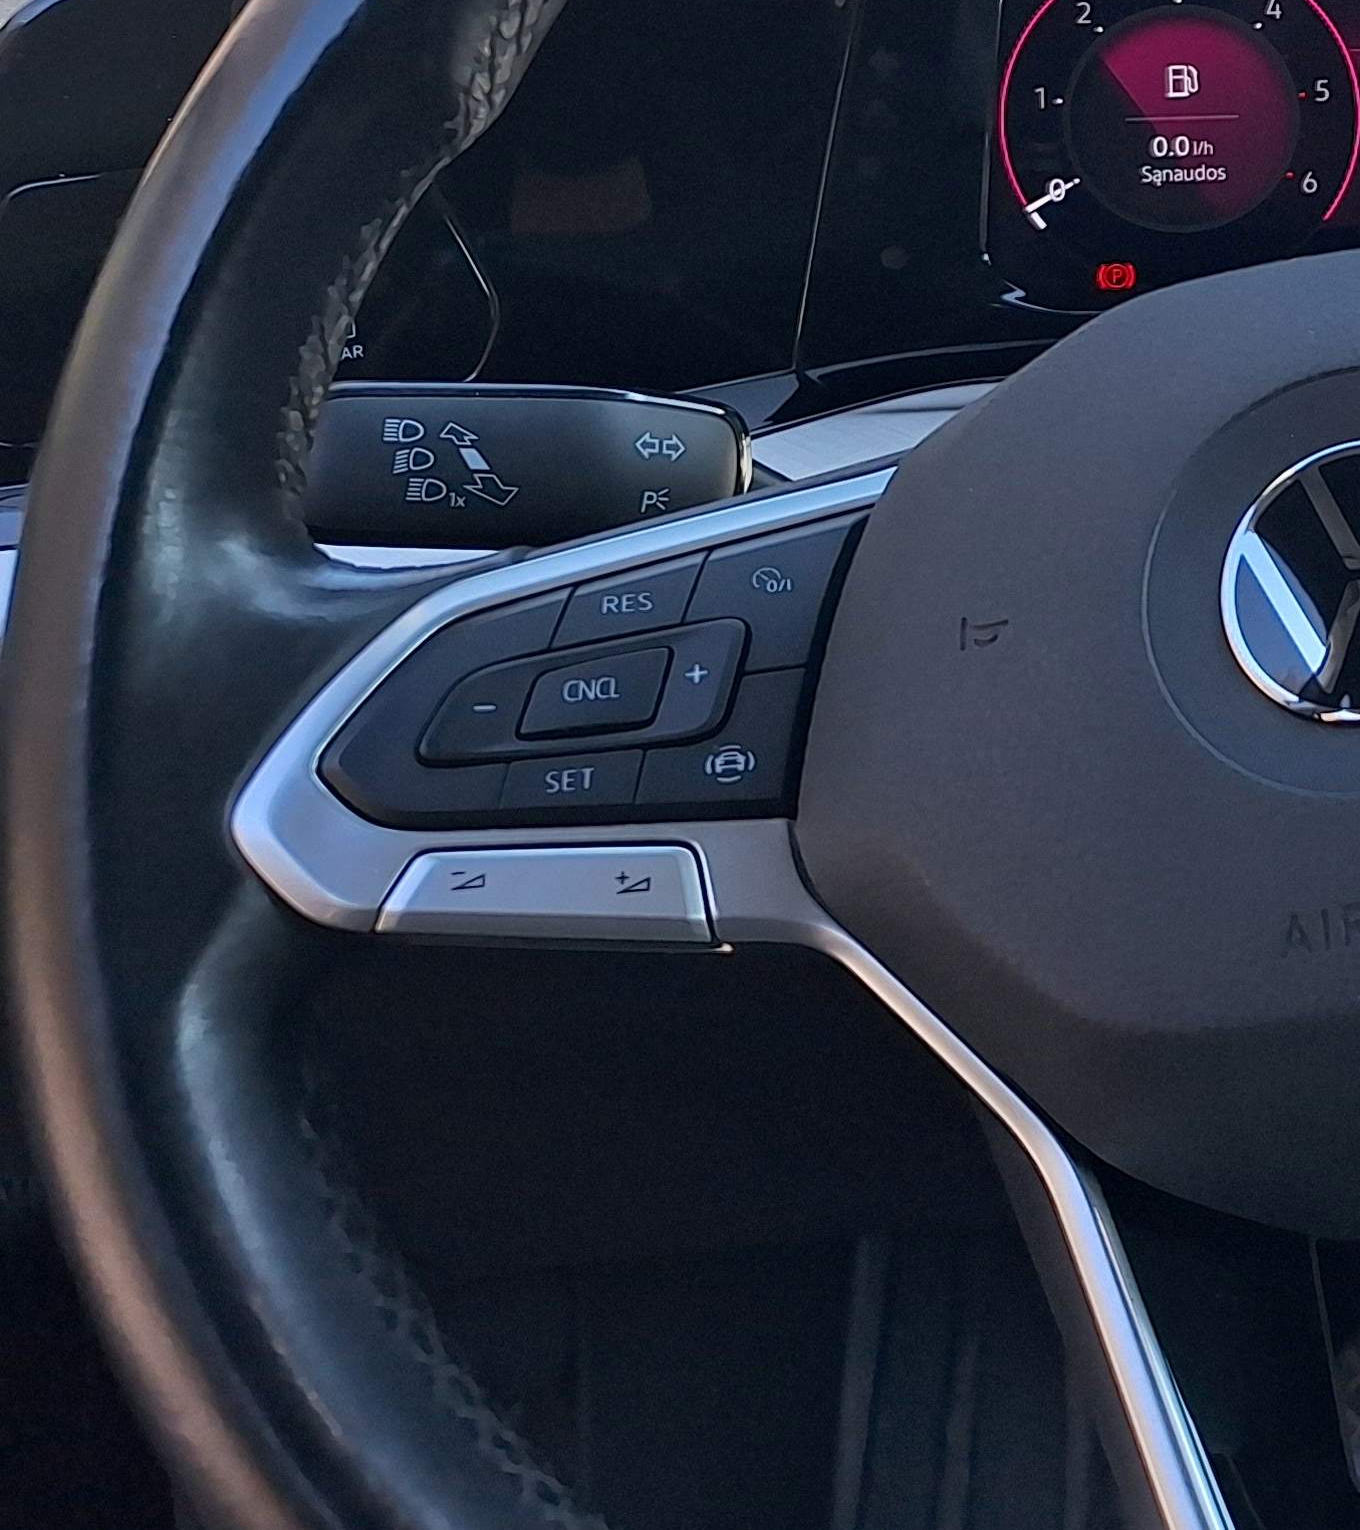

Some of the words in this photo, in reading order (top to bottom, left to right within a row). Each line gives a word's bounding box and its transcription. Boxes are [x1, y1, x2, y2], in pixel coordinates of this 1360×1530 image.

[1076, 2, 1092, 24] 2
[1035, 88, 1047, 109] 1
[1313, 80, 1330, 102] 5
[1152, 136, 1190, 157] 0.0
[1141, 164, 1227, 186] Sąnaudos
[1302, 172, 1318, 193] 6
[1049, 178, 1066, 201] 0
[341, 344, 364, 360] AR
[602, 593, 654, 613] RES
[562, 678, 620, 701] CNCL
[545, 768, 595, 793] SET
